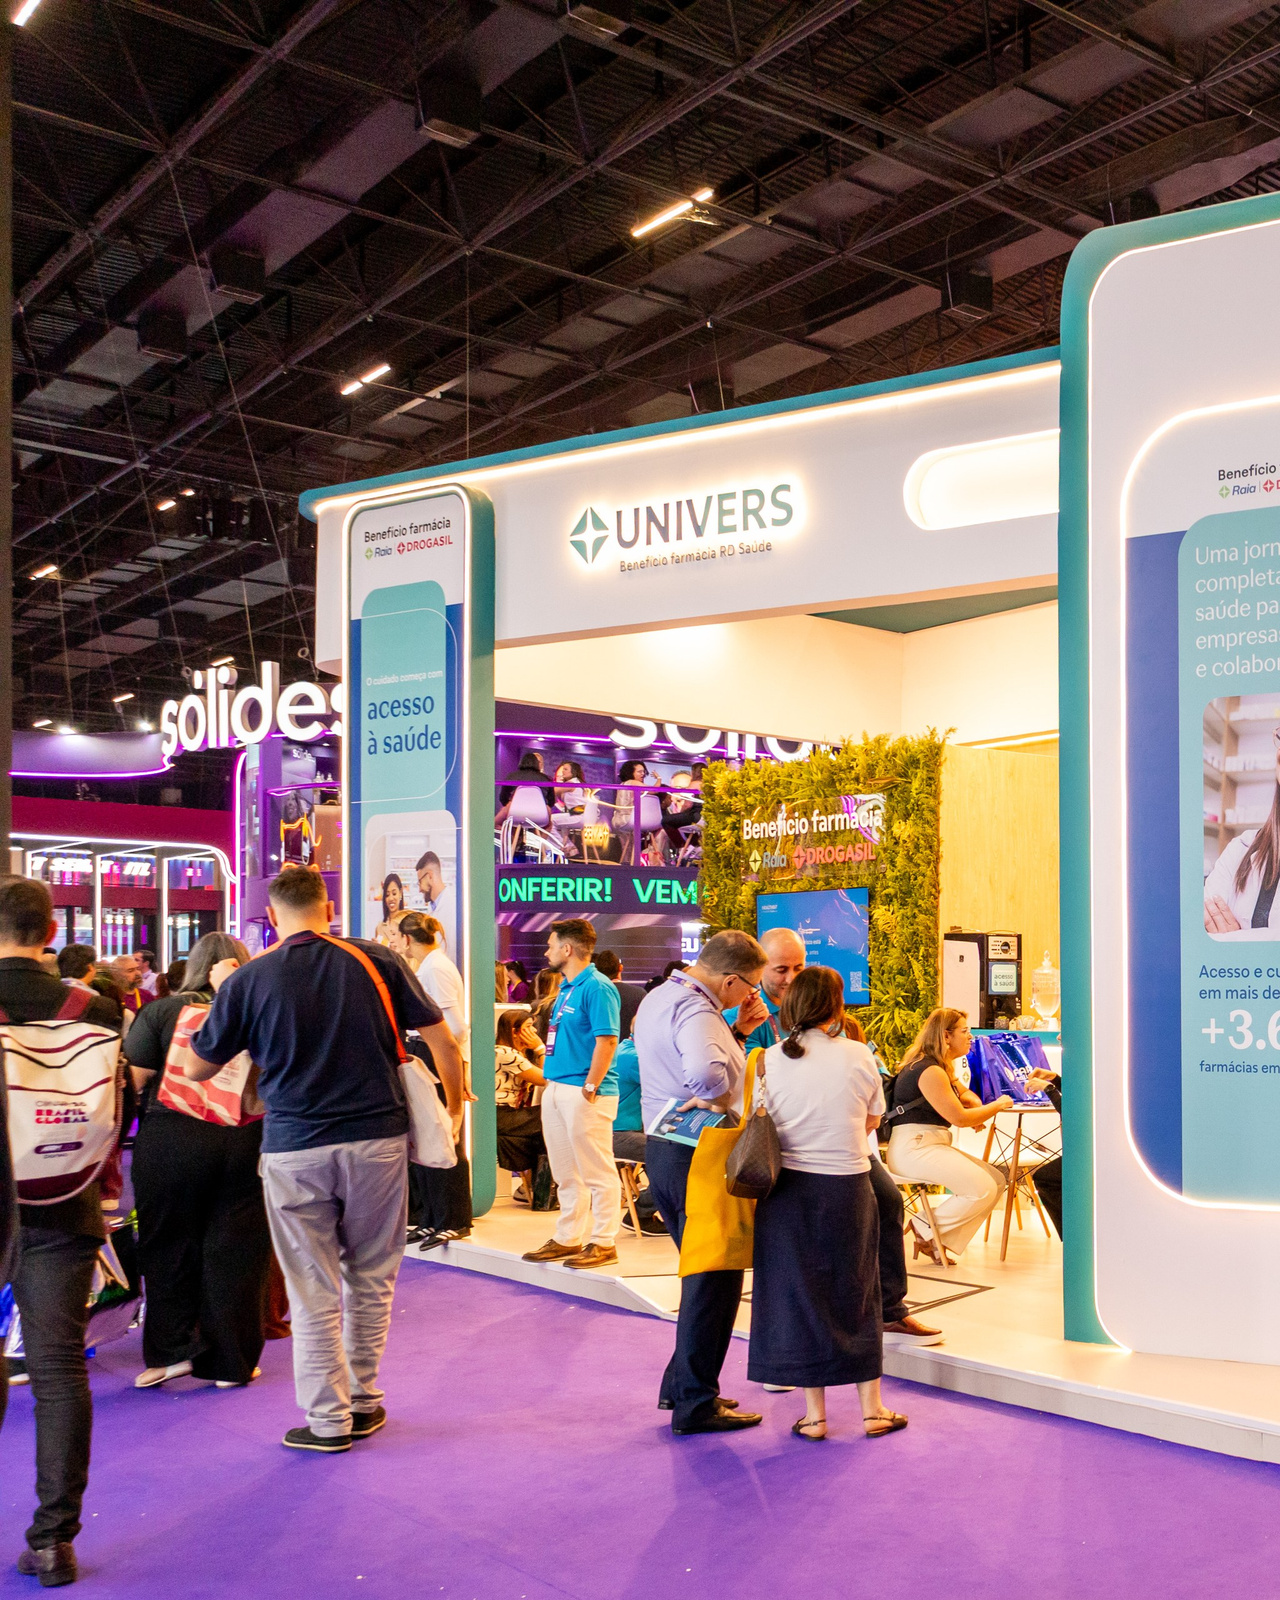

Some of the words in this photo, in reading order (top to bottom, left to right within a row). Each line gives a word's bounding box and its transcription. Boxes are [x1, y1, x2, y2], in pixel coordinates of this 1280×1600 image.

[1218, 462, 1277, 481] Benefício
[1232, 484, 1256, 496] Raia
[616, 484, 793, 549] UNIVERS
[364, 525, 407, 543] Benefício
[409, 516, 451, 535] farmácia
[374, 546, 392, 558] Raia
[406, 535, 453, 552] DROGASIL
[1195, 546, 1239, 565] Uma
[620, 553, 668, 573] Benefício
[671, 548, 717, 565] farmácia
[720, 545, 735, 557] RD
[738, 540, 772, 555] Saúde
[1195, 598, 1251, 622] saúde
[366, 677, 372, 686] O
[373, 675, 399, 685] cuidado
[400, 671, 427, 682] começa
[428, 670, 443, 679] com
[1195, 663, 1207, 678] e
[367, 696, 434, 720] acesso
[367, 730, 377, 755] à
[383, 724, 441, 754] saúde
[743, 811, 809, 840] Benefício
[811, 804, 882, 833] farmácia
[763, 851, 787, 869] Raia
[805, 842, 876, 865] DROGASIL
[499, 877, 612, 903] ONFERIR!
[1199, 965, 1250, 979] Acesso
[1254, 966, 1263, 978] e
[994, 979, 998, 987] à
[1199, 988, 1221, 999] em
[1225, 985, 1258, 1000] mais
[1262, 985, 1280, 999] de
[1199, 1060, 1258, 1073] farmácias
[1262, 1063, 1280, 1074] em
[35, 1108, 86, 1116] BRASIL
[35, 1116, 90, 1124] GLOBAL
